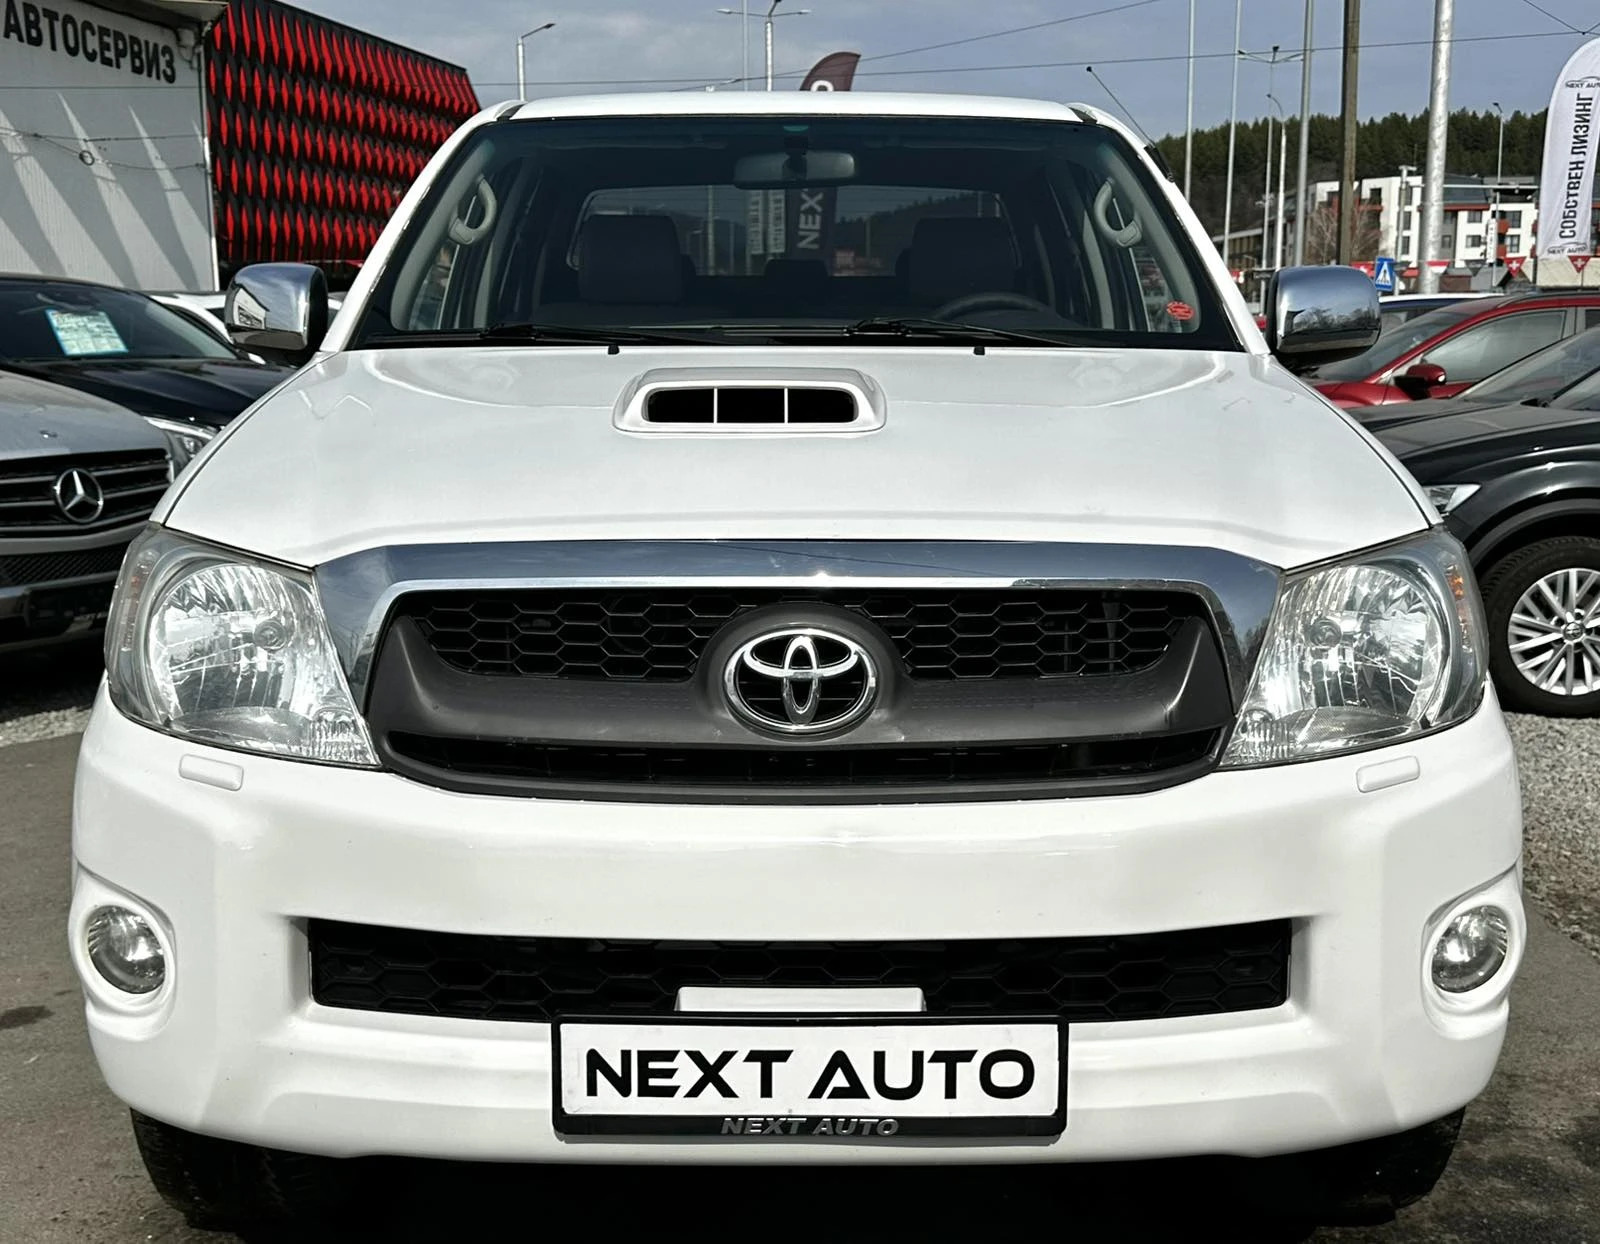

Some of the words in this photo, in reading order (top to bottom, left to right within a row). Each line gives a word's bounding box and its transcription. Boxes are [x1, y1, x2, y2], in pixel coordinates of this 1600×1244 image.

[3, 0, 176, 84] АВТОСЕРВИЗ
[1571, 93, 1593, 156] ЛИЗИНГ
[797, 188, 823, 249] NEX
[1559, 160, 1585, 238] СОБСТВЕН
[586, 1048, 794, 1098] NEXT
[808, 1049, 1035, 1100] AUTO
[721, 1117, 807, 1134] NEXT
[812, 1117, 899, 1135] AUTO
